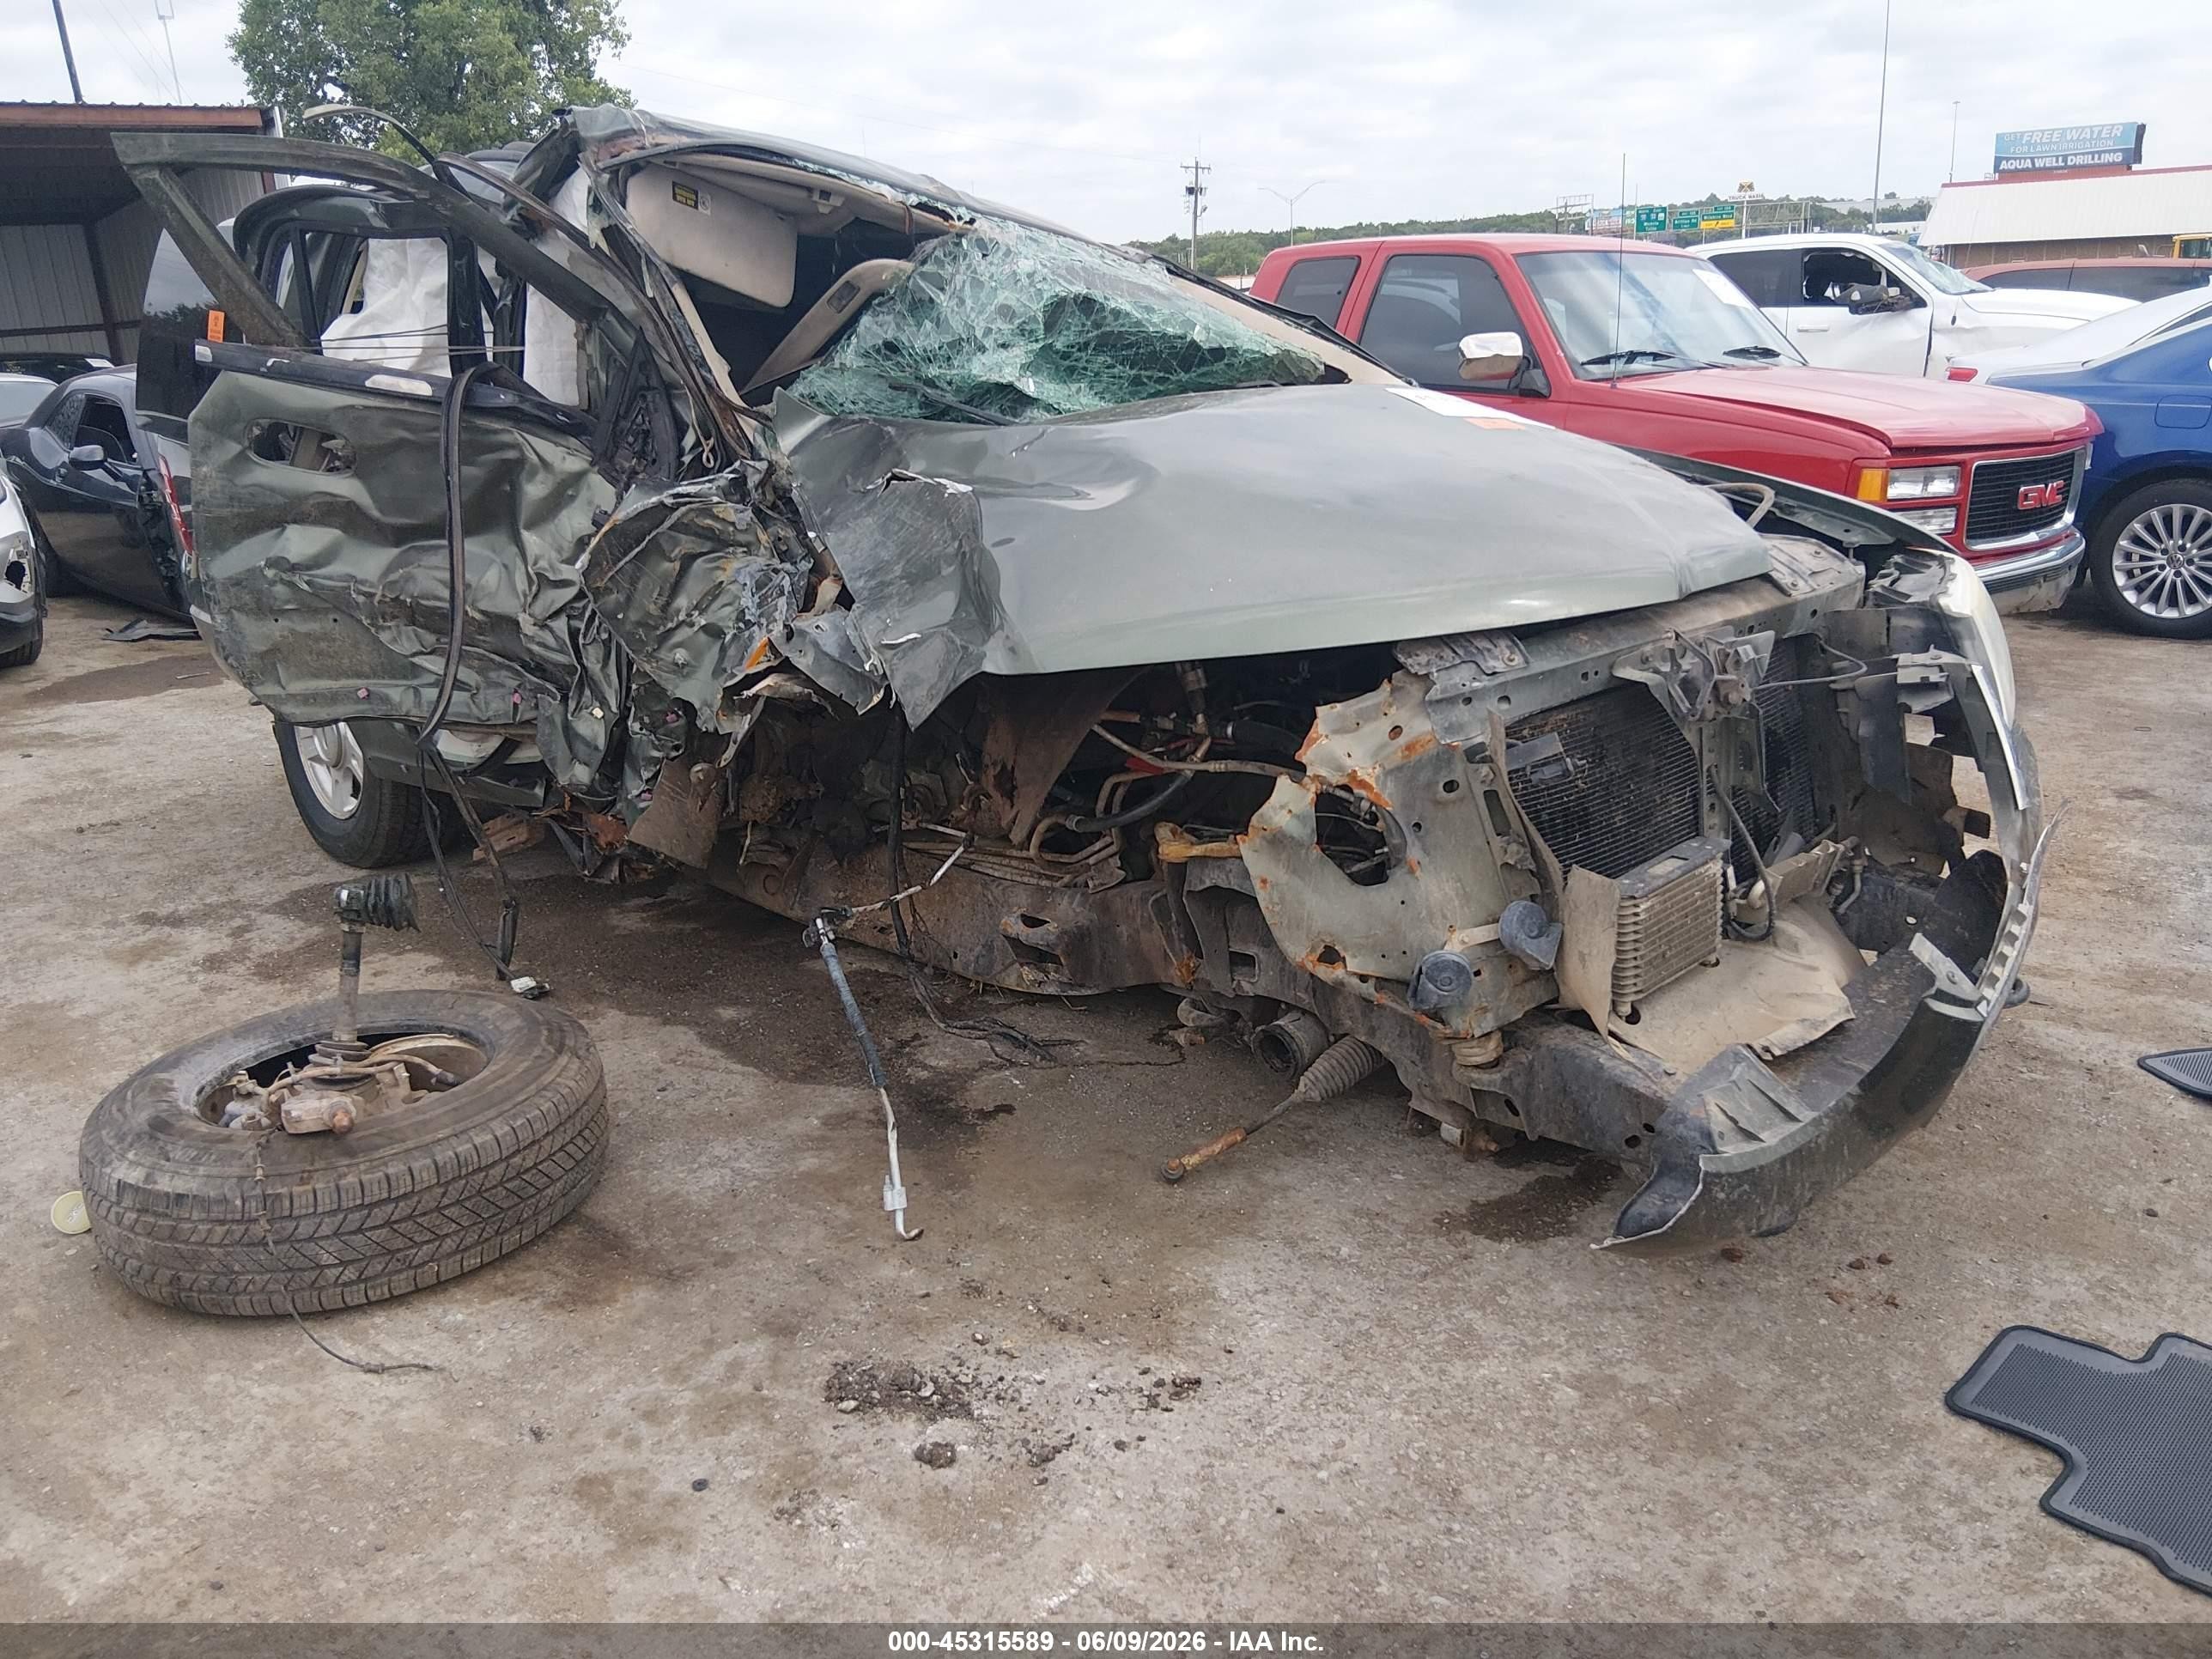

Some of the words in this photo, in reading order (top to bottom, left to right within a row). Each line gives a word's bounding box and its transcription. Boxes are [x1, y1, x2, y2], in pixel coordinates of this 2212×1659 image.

[2004, 133, 2021, 142] GET
[2022, 130, 2063, 144] FREE
[2066, 125, 2124, 140] WATER
[2030, 143, 2057, 153] LAWN
[2059, 139, 2114, 150] IRRIGATION
[1999, 158, 2033, 170] AQUA
[2034, 155, 2065, 168] WELL
[2067, 152, 2123, 165] DRILLING
[2018, 480, 2064, 510] GMC
